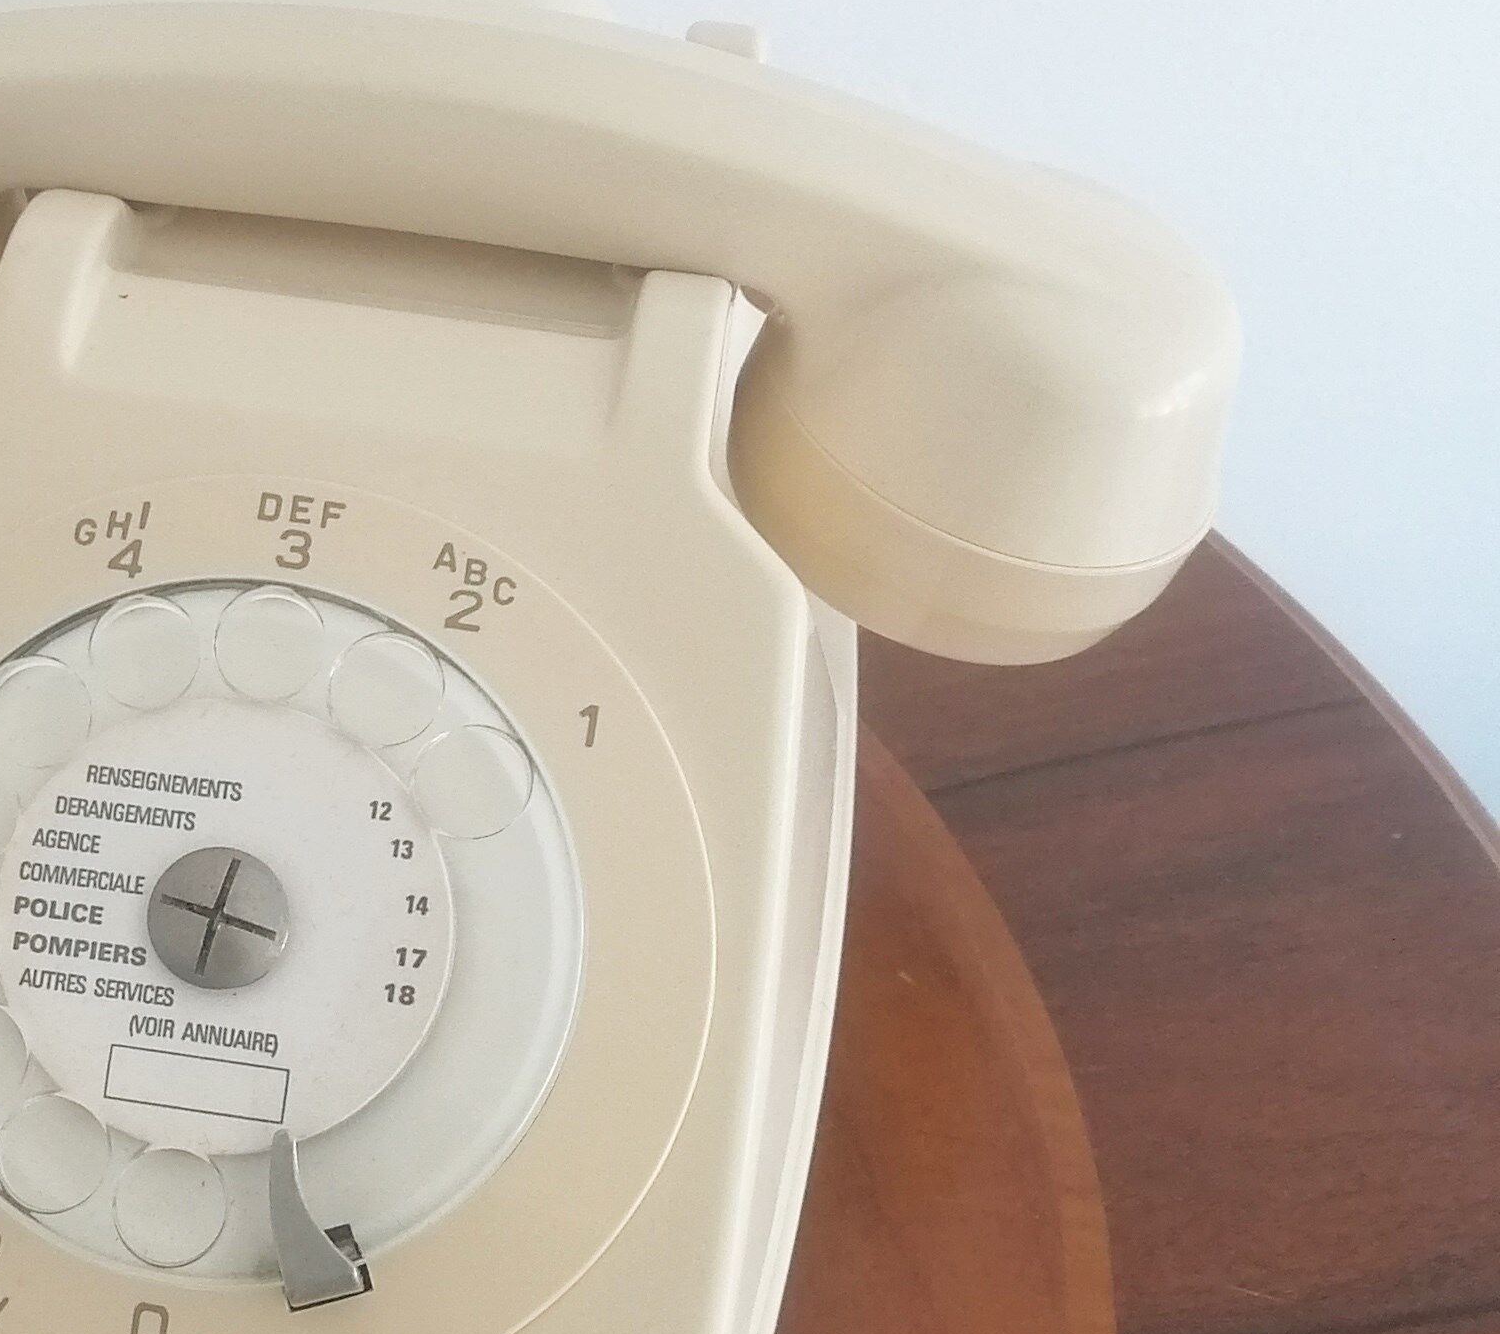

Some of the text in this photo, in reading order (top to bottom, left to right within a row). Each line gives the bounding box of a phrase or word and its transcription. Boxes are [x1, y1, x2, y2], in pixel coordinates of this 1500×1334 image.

[107, 538, 143, 579] 4
[274, 528, 313, 571] 3
[443, 589, 484, 633] 2
[578, 704, 600, 748] 1
[85, 764, 243, 802] RENSEIGNEMENTS
[54, 795, 197, 831] DERANGEMENTS
[369, 800, 393, 822] 12
[31, 827, 102, 855] AGENCE
[391, 838, 414, 860] 13
[18, 860, 146, 895] COMMERCIALE
[13, 895, 105, 926] POLICE
[405, 894, 429, 916] 14
[12, 931, 148, 966] POMPIERS
[395, 946, 428, 969] 17
[18, 967, 175, 1007] AUTRES SERVICES
[384, 982, 416, 1006] 18
[128, 1014, 279, 1059] (VOIR ANNUAIRE)
